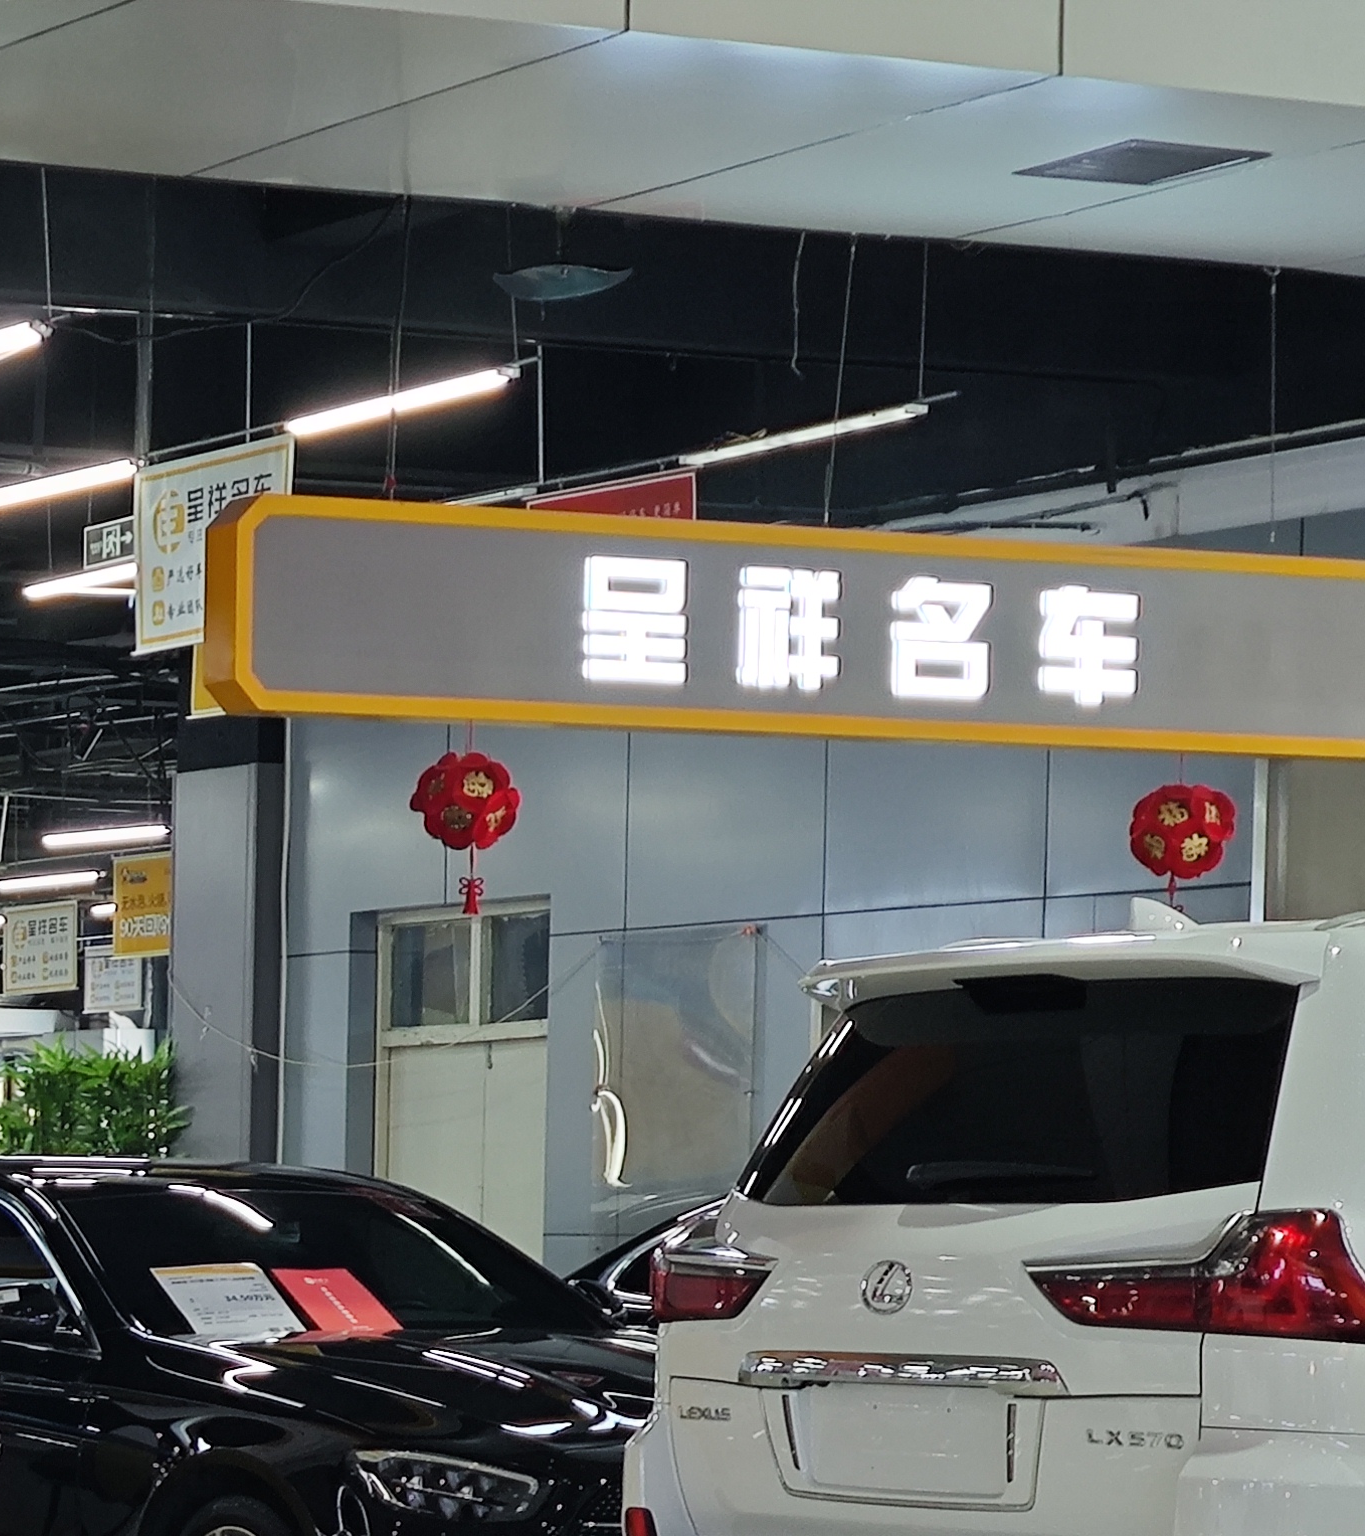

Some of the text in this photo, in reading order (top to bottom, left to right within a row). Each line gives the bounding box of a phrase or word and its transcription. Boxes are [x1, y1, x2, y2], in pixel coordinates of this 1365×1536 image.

[581, 553, 1142, 707] 呈祥名车
[678, 1405, 731, 1421] LEXUS
[1087, 1429, 1184, 1450] LX 570
